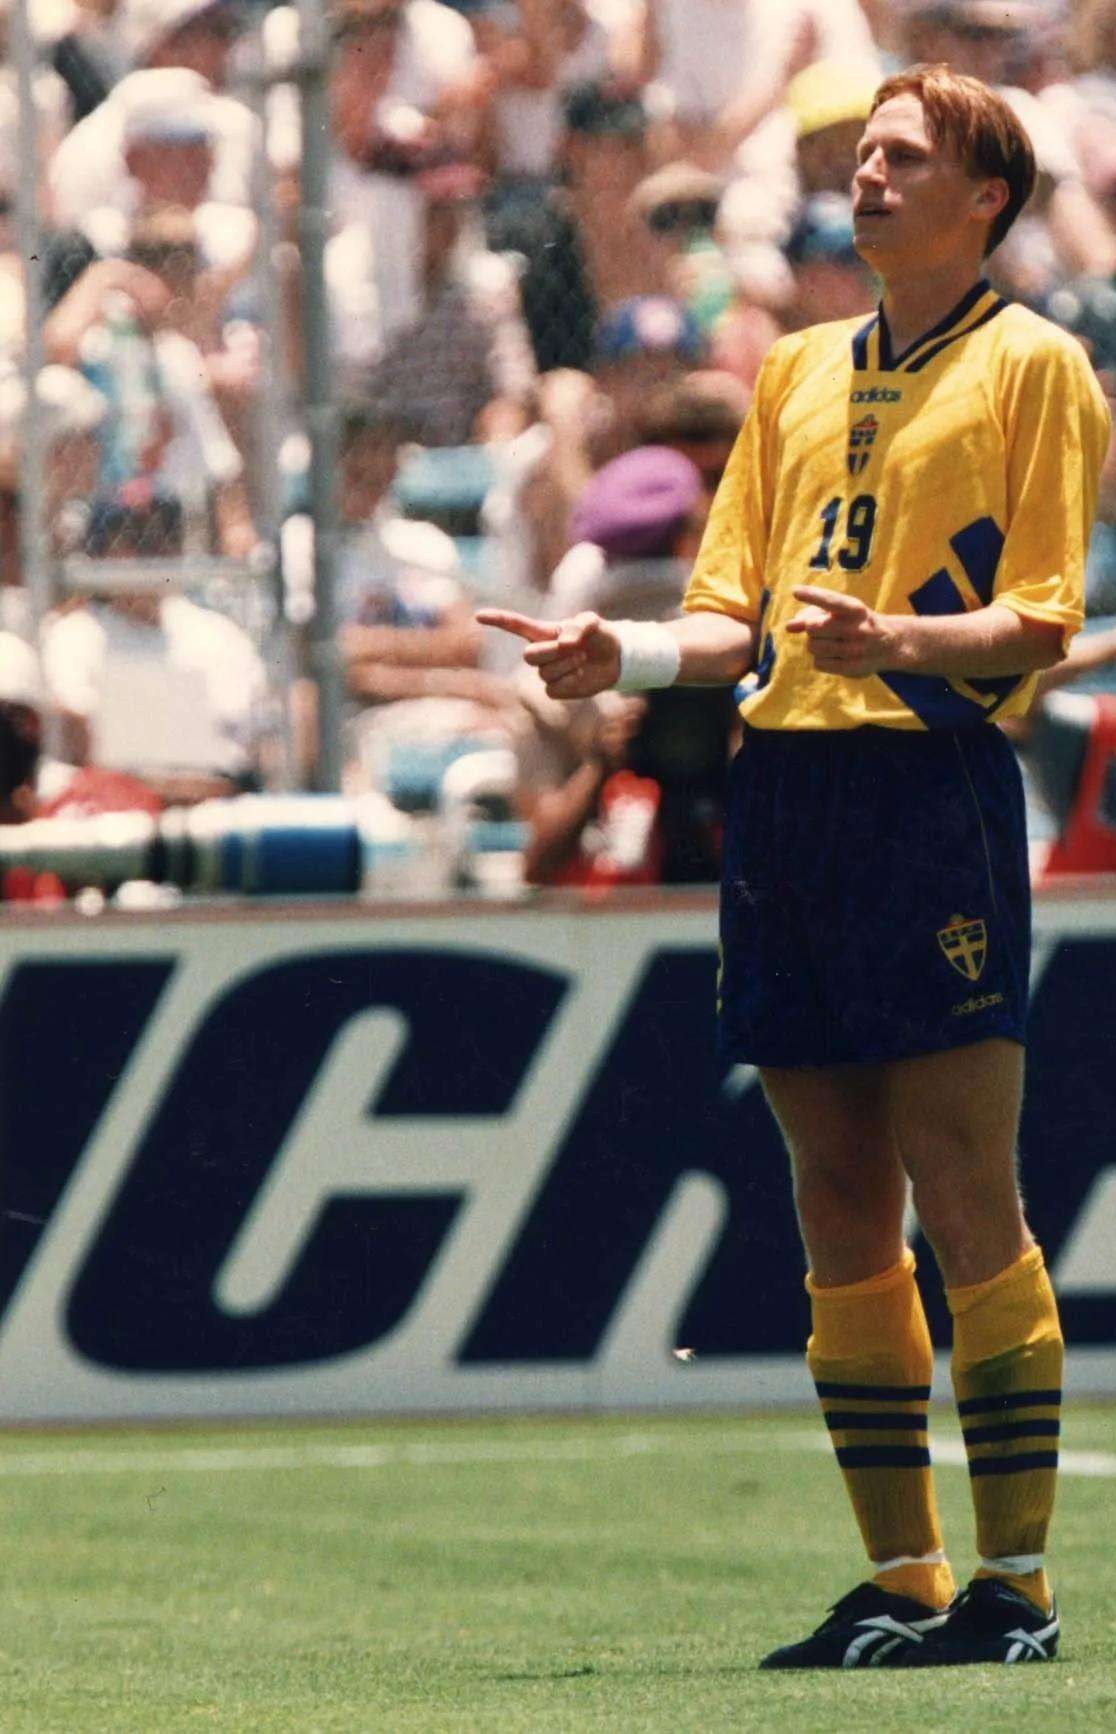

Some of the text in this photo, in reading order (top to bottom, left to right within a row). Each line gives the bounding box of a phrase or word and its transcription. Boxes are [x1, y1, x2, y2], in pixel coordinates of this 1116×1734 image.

[849, 387, 902, 404] adidas
[808, 493, 879, 574] 19
[951, 992, 1004, 1016] adidas
